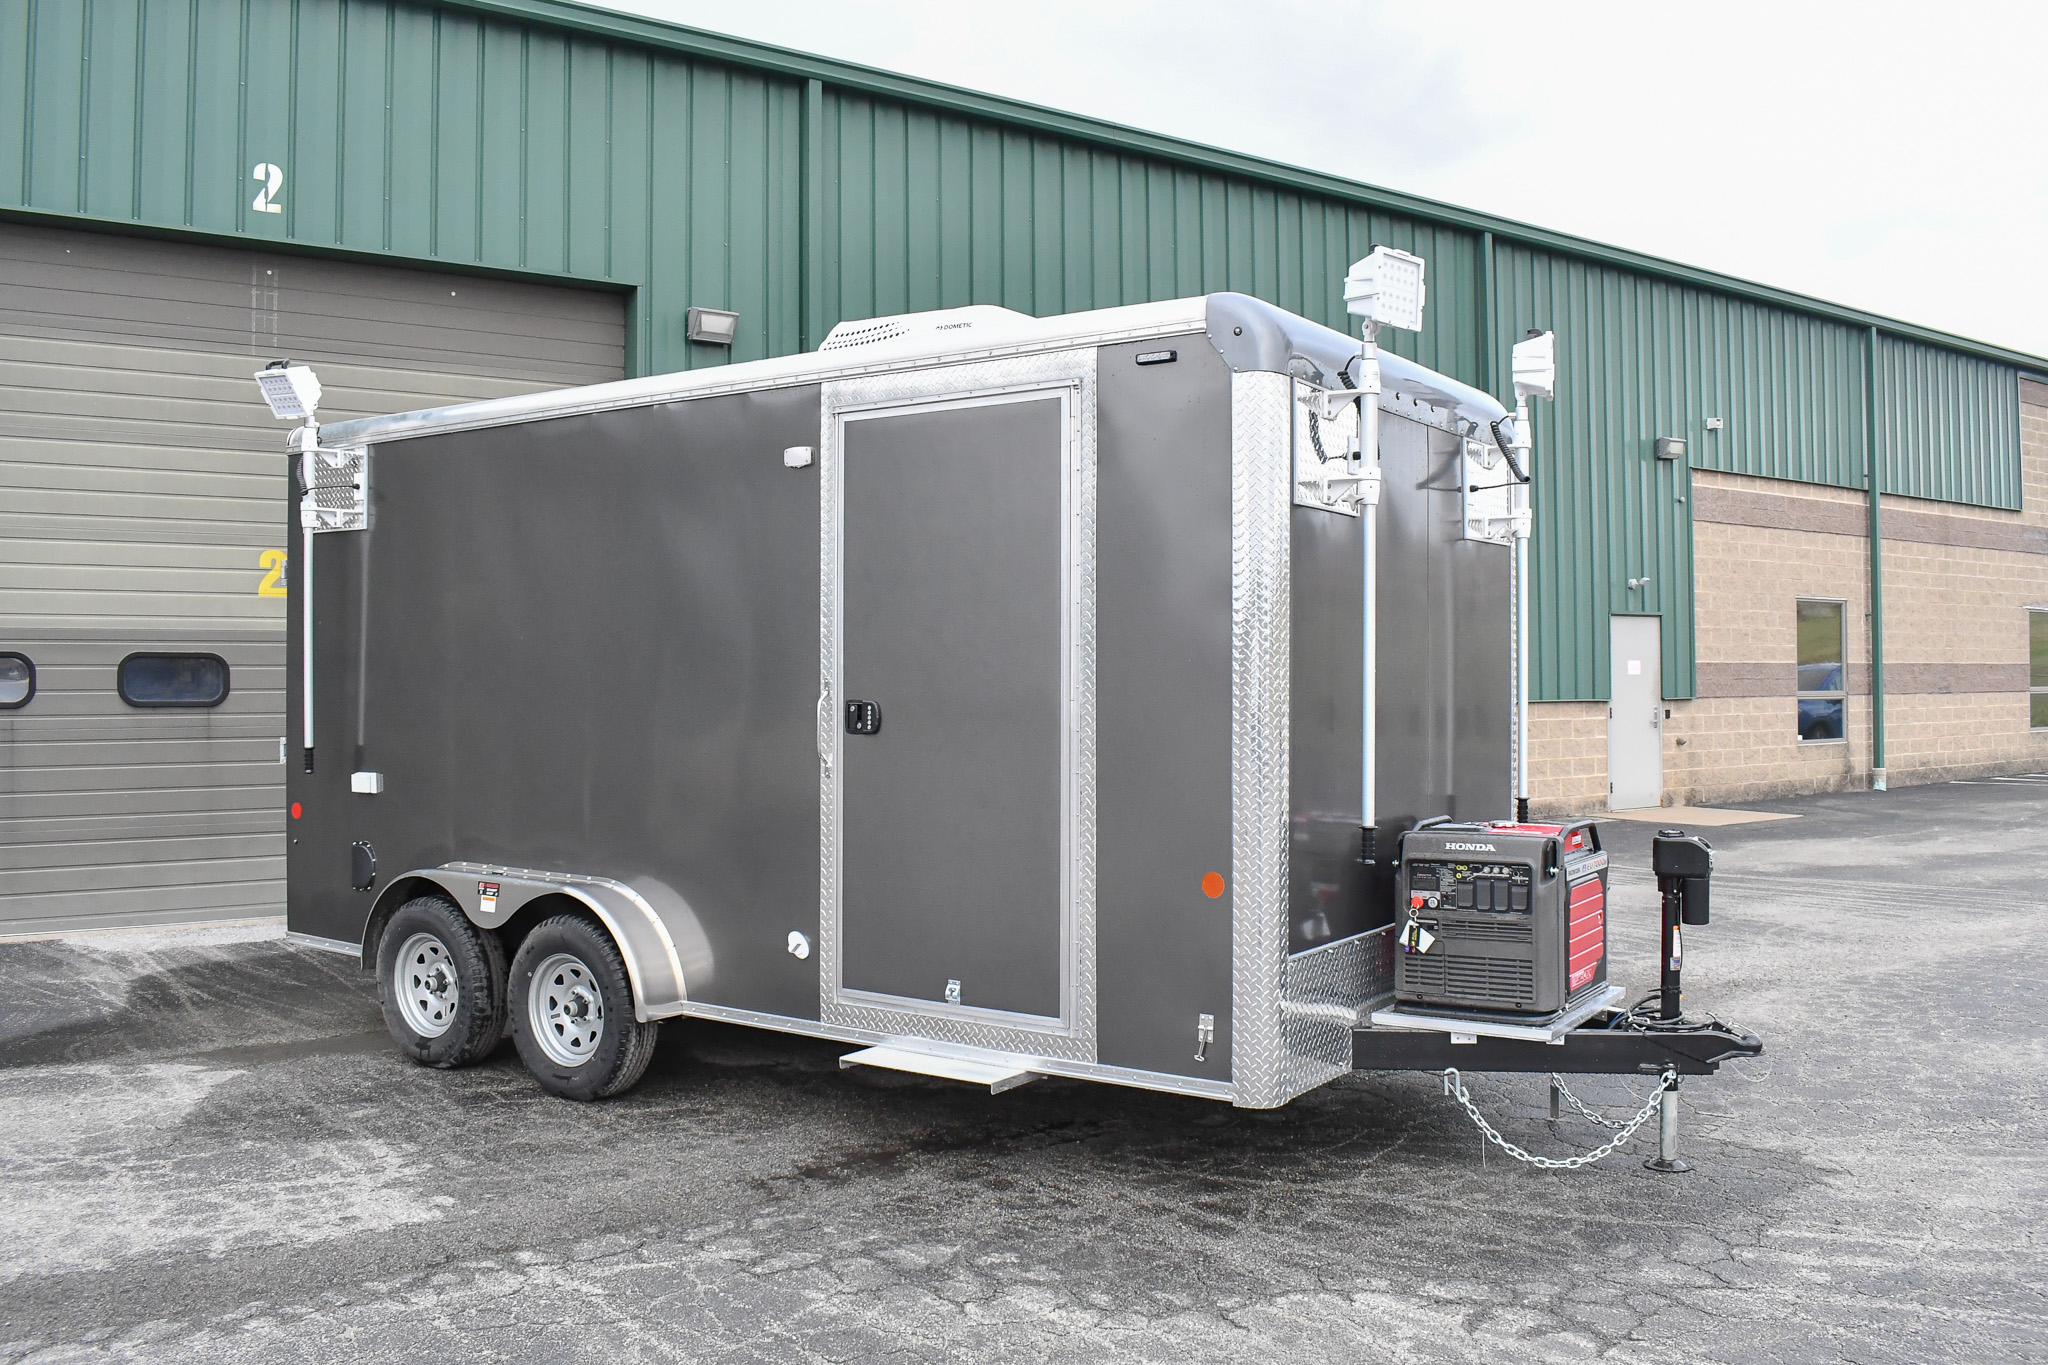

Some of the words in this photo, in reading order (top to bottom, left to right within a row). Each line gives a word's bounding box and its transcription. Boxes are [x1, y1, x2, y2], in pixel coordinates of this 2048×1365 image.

[252, 162, 283, 214] 2
[943, 322, 972, 330] DOMETIC
[258, 549, 288, 597] 2
[1444, 842, 1497, 852] HONDA
